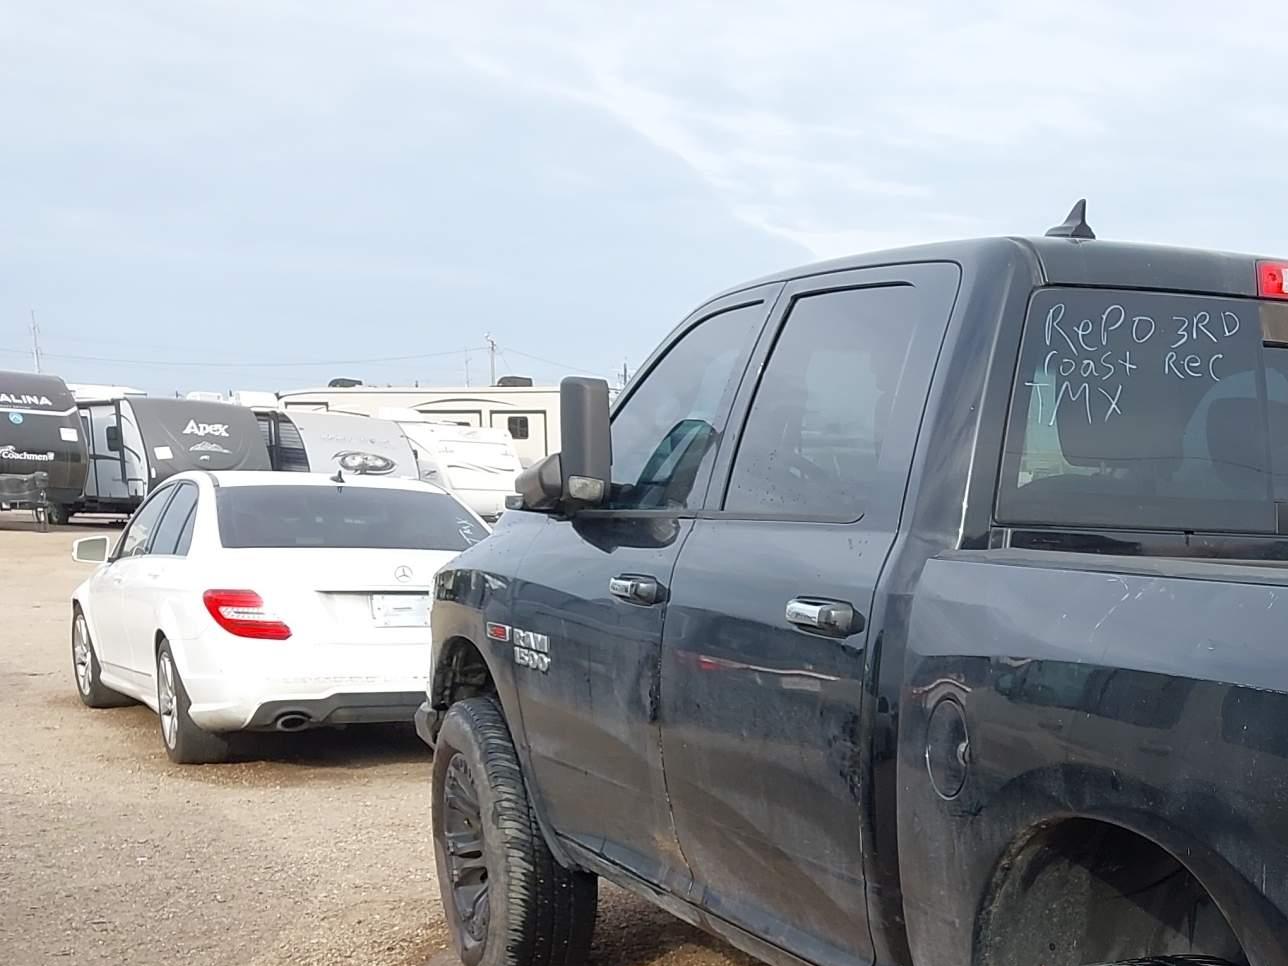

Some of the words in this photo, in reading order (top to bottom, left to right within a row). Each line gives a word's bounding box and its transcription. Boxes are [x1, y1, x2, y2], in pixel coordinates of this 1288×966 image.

[1170, 311, 1240, 349] 3RD
[1024, 380, 1123, 426] TMX
[1, 451, 49, 462] Coachmen
[513, 628, 549, 653] RAM
[513, 646, 550, 672] 1500
